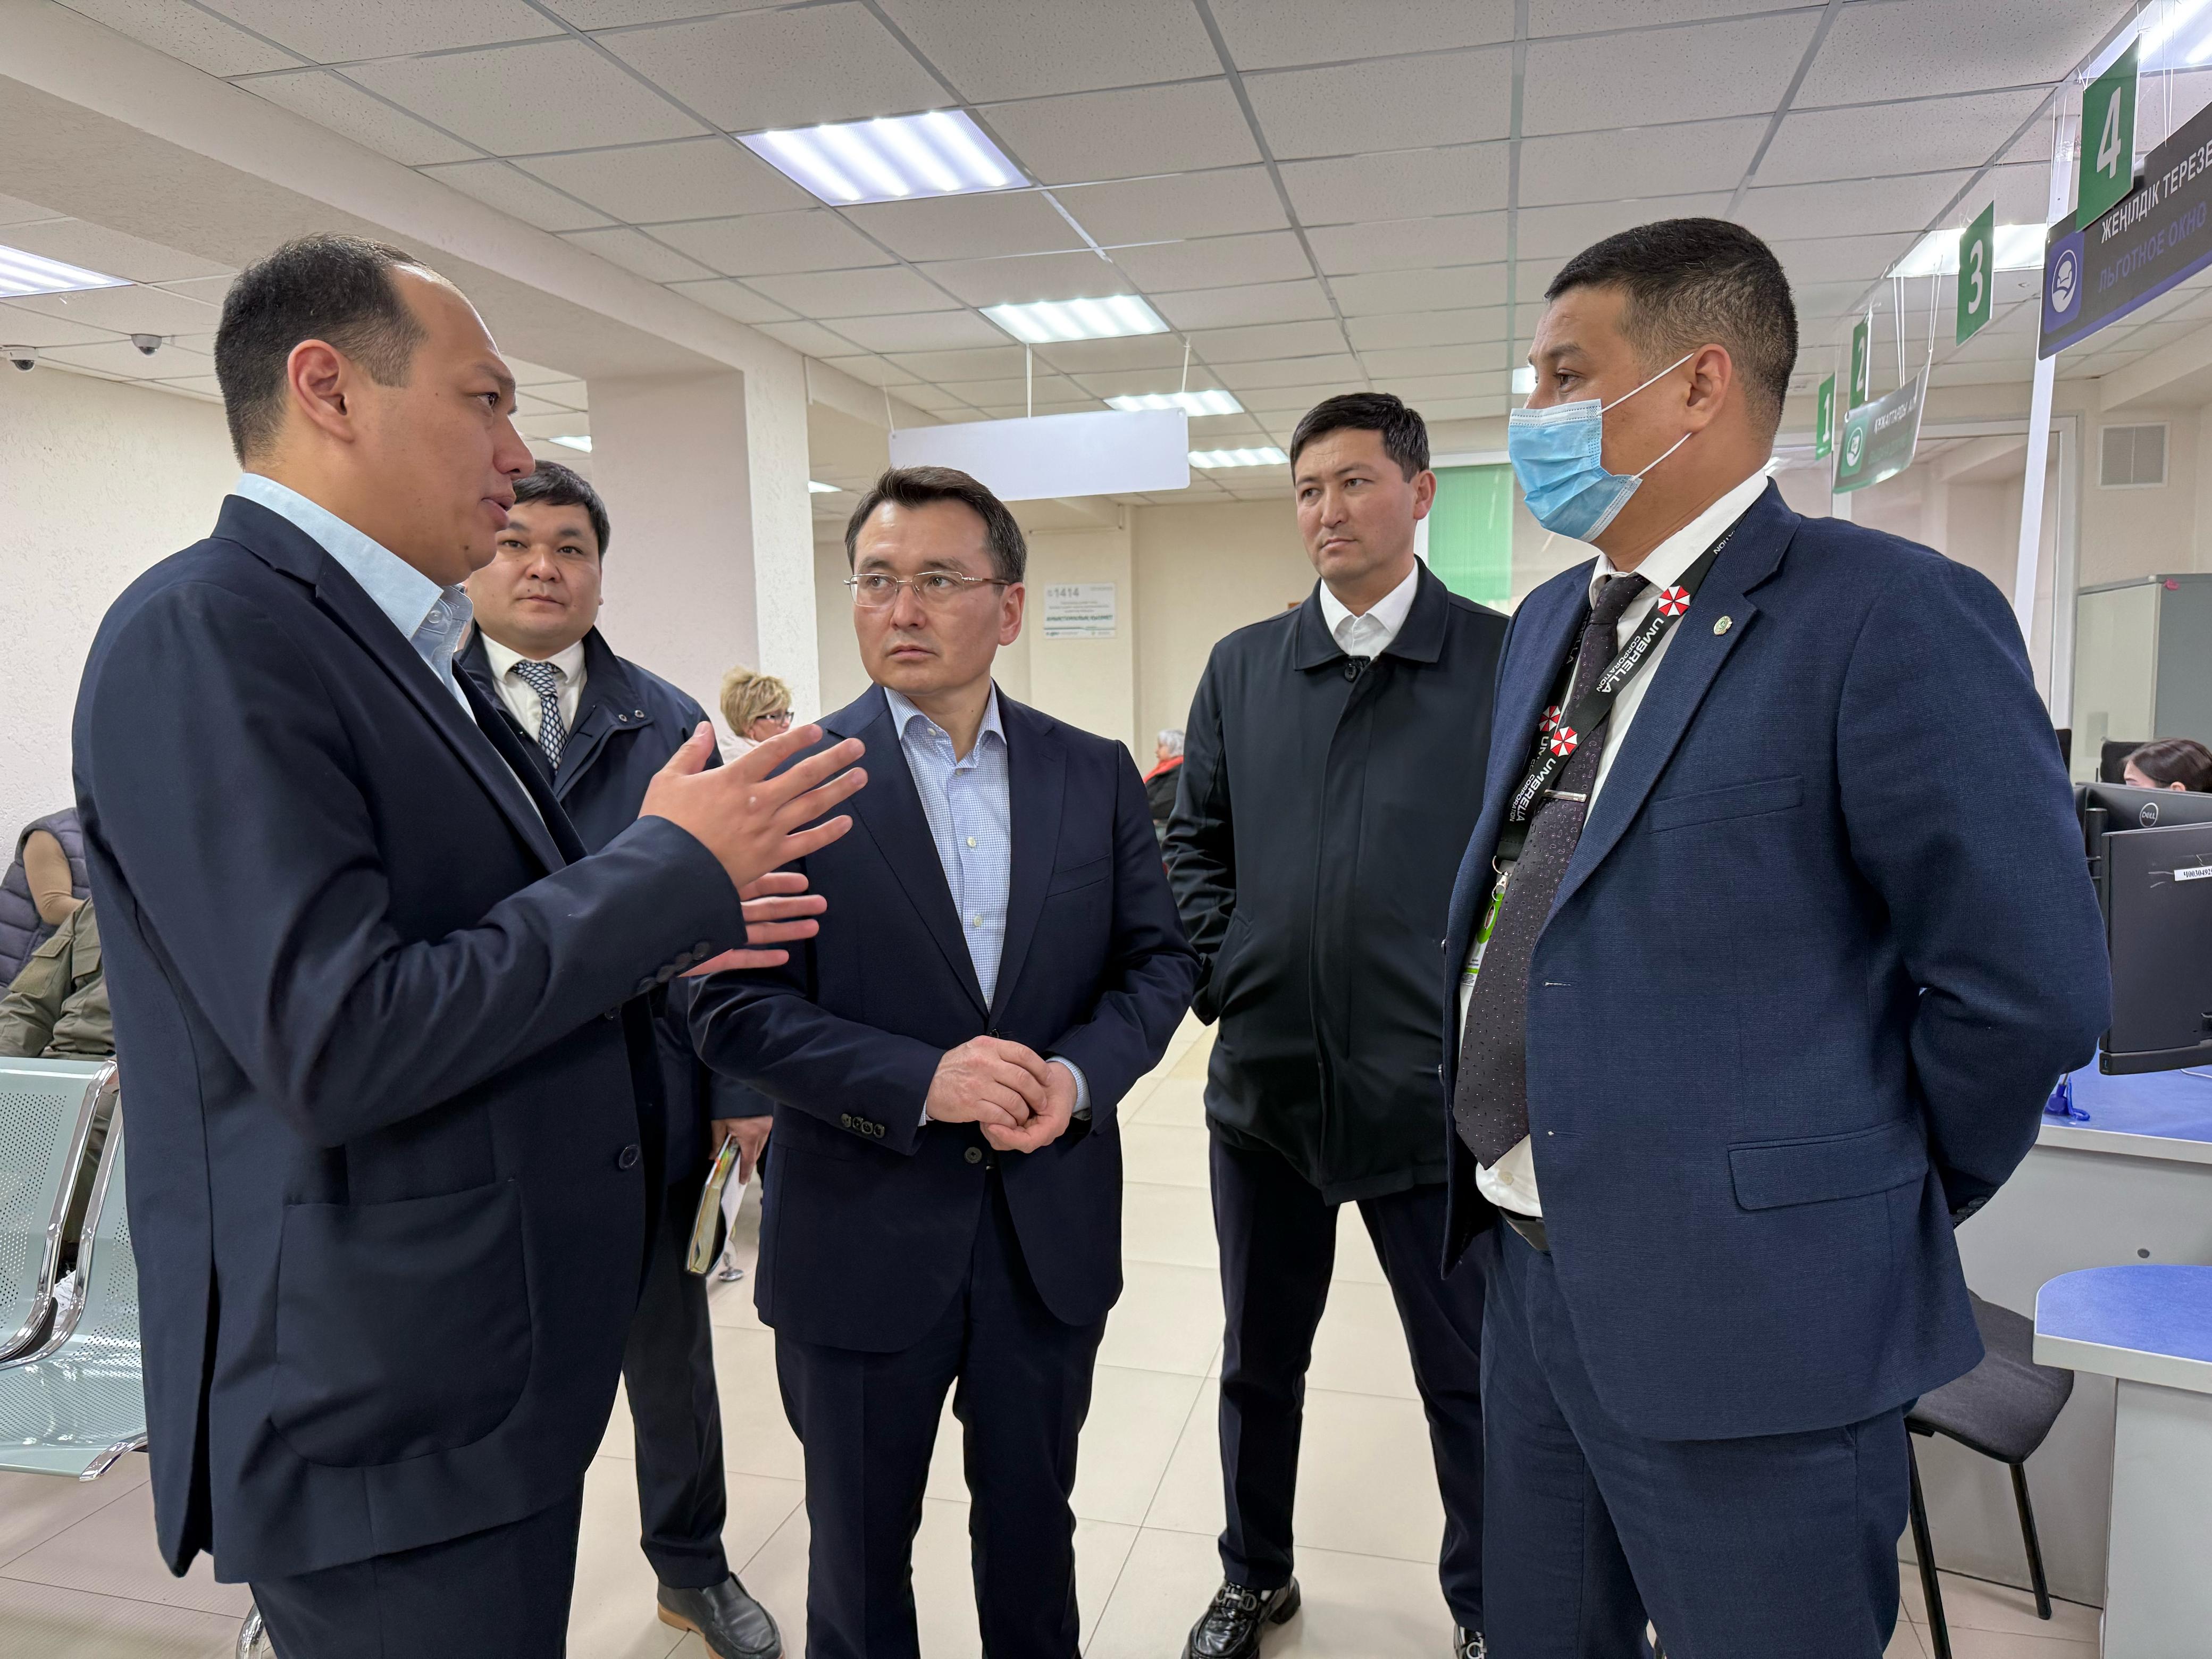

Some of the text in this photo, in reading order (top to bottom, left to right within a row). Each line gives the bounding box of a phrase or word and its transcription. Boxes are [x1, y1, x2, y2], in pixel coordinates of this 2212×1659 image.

[2097, 86, 2121, 179] 4
[2101, 180, 2159, 244] ЖЕҢІЛДІК
[1968, 240, 1983, 314] 3
[2099, 201, 2206, 292] ЛЬГОТНОЕ ОКНО
[1856, 337, 1865, 392] 2
[1823, 393, 1830, 443] 1
[1054, 588, 1079, 598] 1414
[1596, 635, 1641, 692] CORPORATION
[1602, 617, 1664, 693] UMBRELLA
[1509, 774, 1535, 822] CORPORATION
[1516, 758, 1556, 821] UMBRELLA
